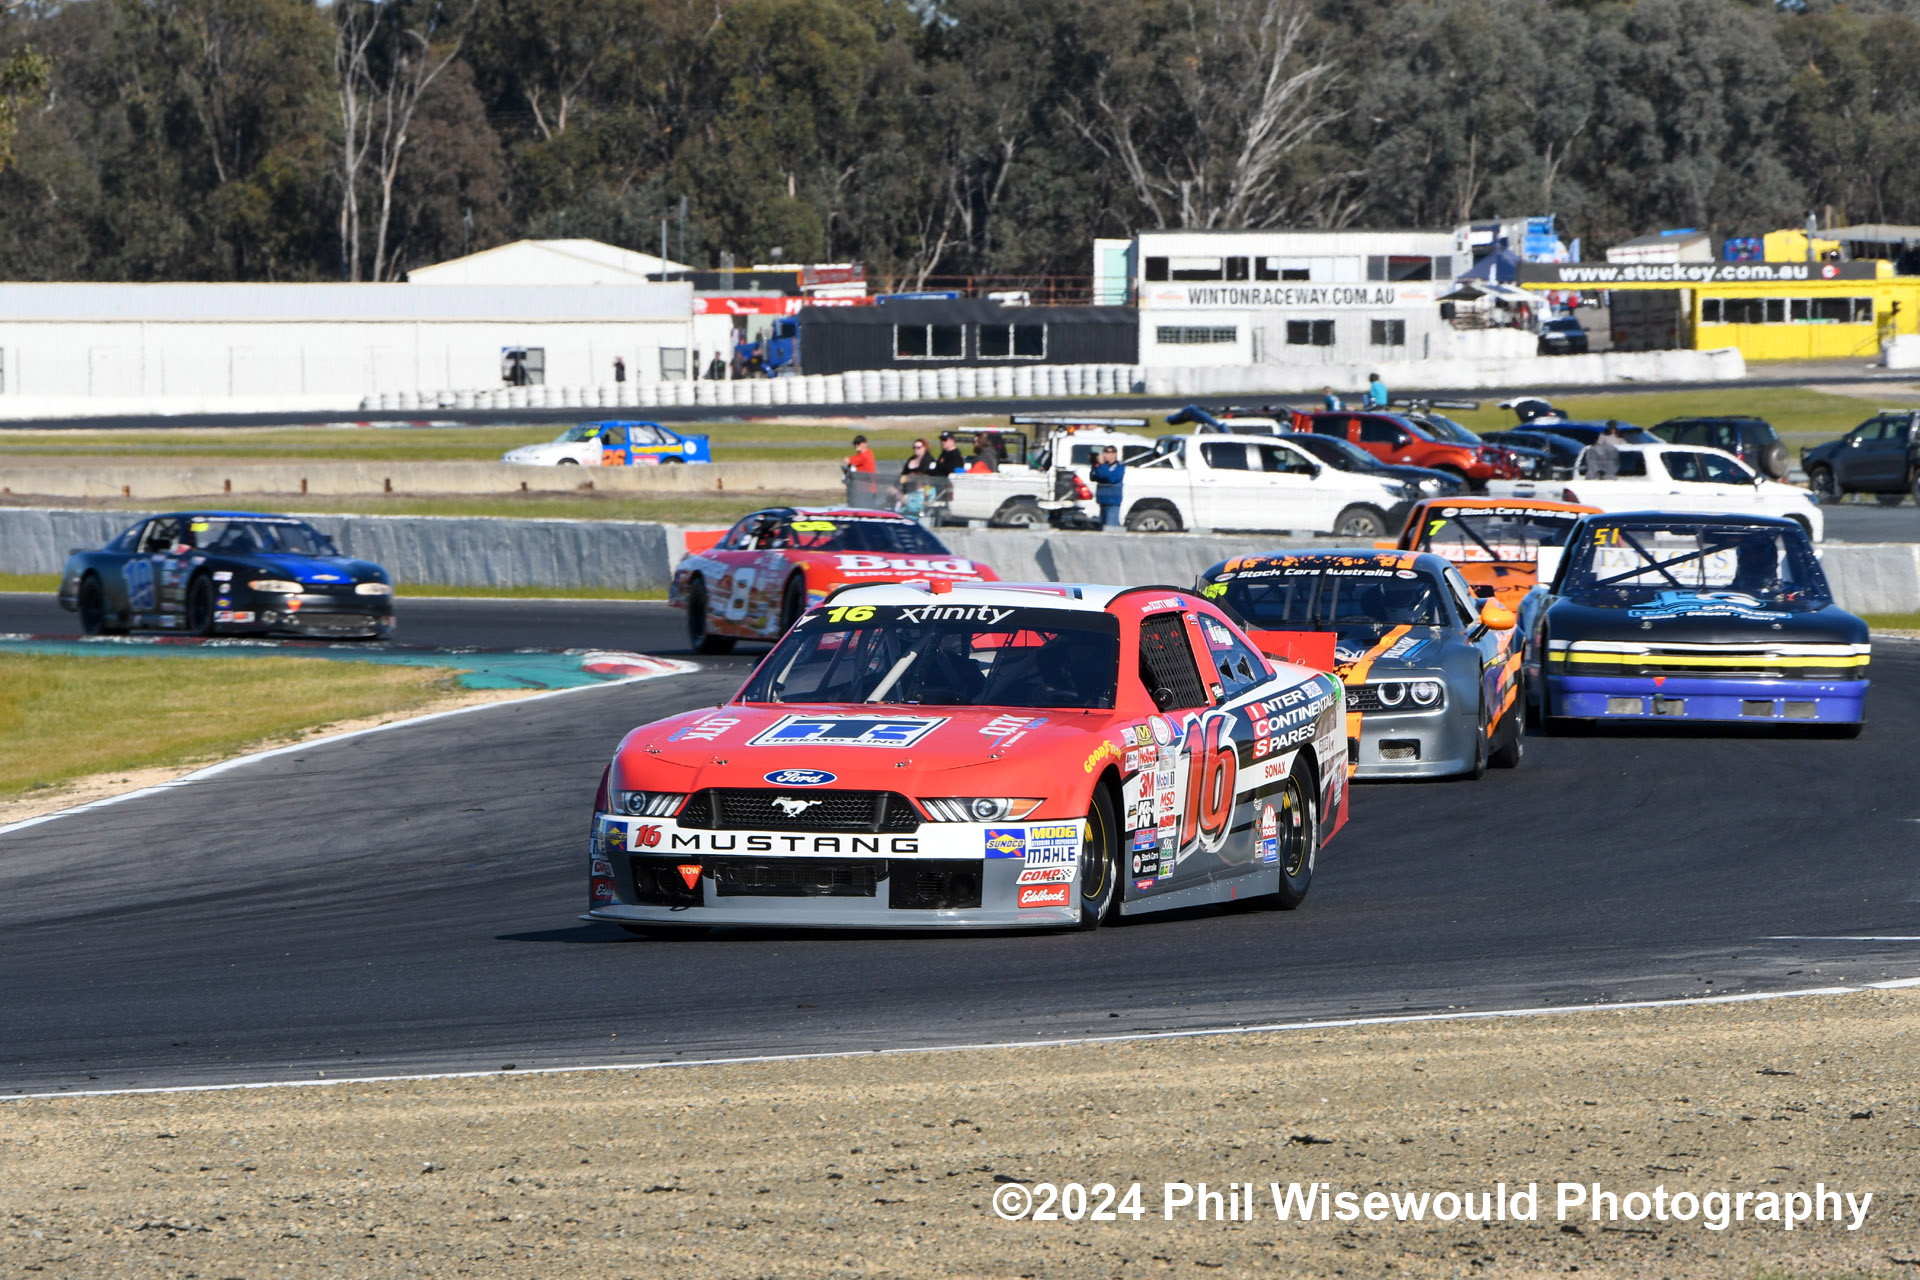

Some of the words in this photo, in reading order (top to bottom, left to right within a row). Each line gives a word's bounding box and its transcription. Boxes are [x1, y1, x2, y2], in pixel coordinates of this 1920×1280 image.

[1558, 263, 1809, 282] www.stuckey.com.au
[1188, 288, 1395, 305] WINTONRACEWAY.COM.AU
[1495, 507, 1523, 515] Cars
[1429, 520, 1447, 536] 7
[1593, 528, 1620, 545] 51
[833, 554, 979, 575] Bud
[1237, 569, 1281, 579] Stock
[1283, 568, 1321, 576] Cars
[1326, 568, 1394, 578] Australia
[827, 606, 877, 623] 16
[896, 605, 1016, 624] xfinity
[1250, 690, 1305, 718] INTER
[1256, 694, 1334, 737] CONTINENTAL
[1255, 723, 1316, 757] SPARES
[776, 770, 825, 784] Ford
[1264, 761, 1286, 779] SONAX
[1139, 772, 1155, 798] 3M
[1156, 772, 1169, 788] Mobil
[1178, 712, 1238, 858] 16
[1160, 791, 1175, 807] MSD
[634, 825, 663, 848] 16
[1031, 826, 1076, 839] MOOG
[1262, 828, 1277, 837] TOOLS
[671, 833, 919, 853] MUSTANG
[988, 840, 1025, 848] SUNOCO
[1027, 847, 1076, 864] MAHLE
[681, 867, 699, 875] TOW
[1021, 869, 1061, 881] COMP
[1021, 889, 1065, 903] Edelbrock
